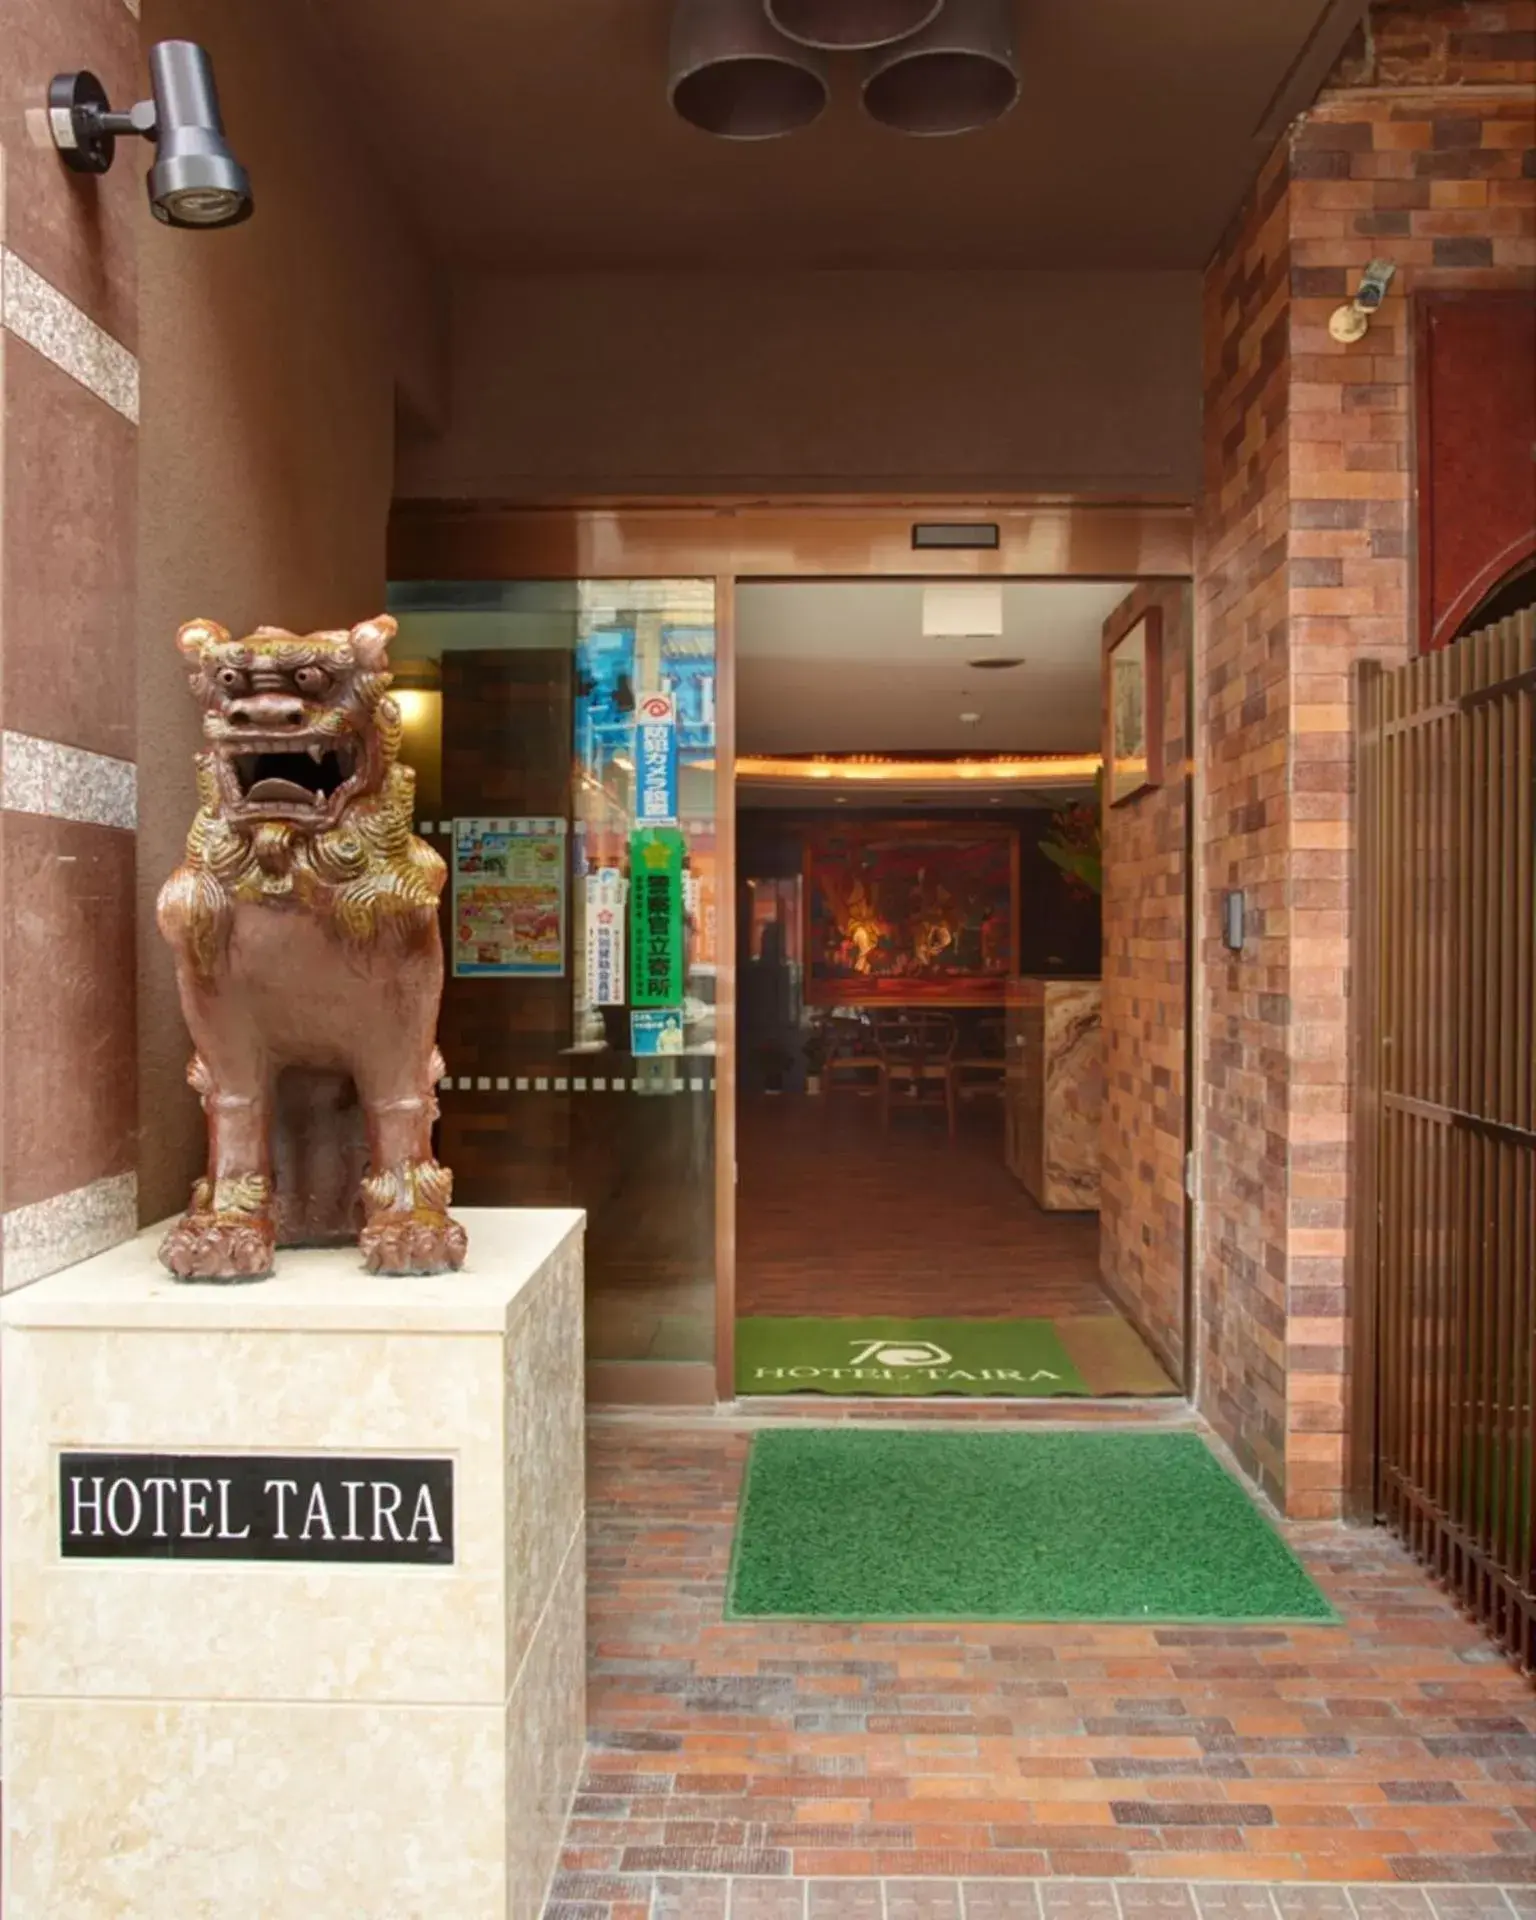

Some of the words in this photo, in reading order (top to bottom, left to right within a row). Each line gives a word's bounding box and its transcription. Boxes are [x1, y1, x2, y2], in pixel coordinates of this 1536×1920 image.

[647, 874, 671, 998] 警察官立寄所
[754, 1366, 911, 1380] HOTEL
[916, 1368, 1062, 1382] TAIRA
[69, 1476, 251, 1539] HOTEL
[263, 1479, 444, 1543] TAIRA
